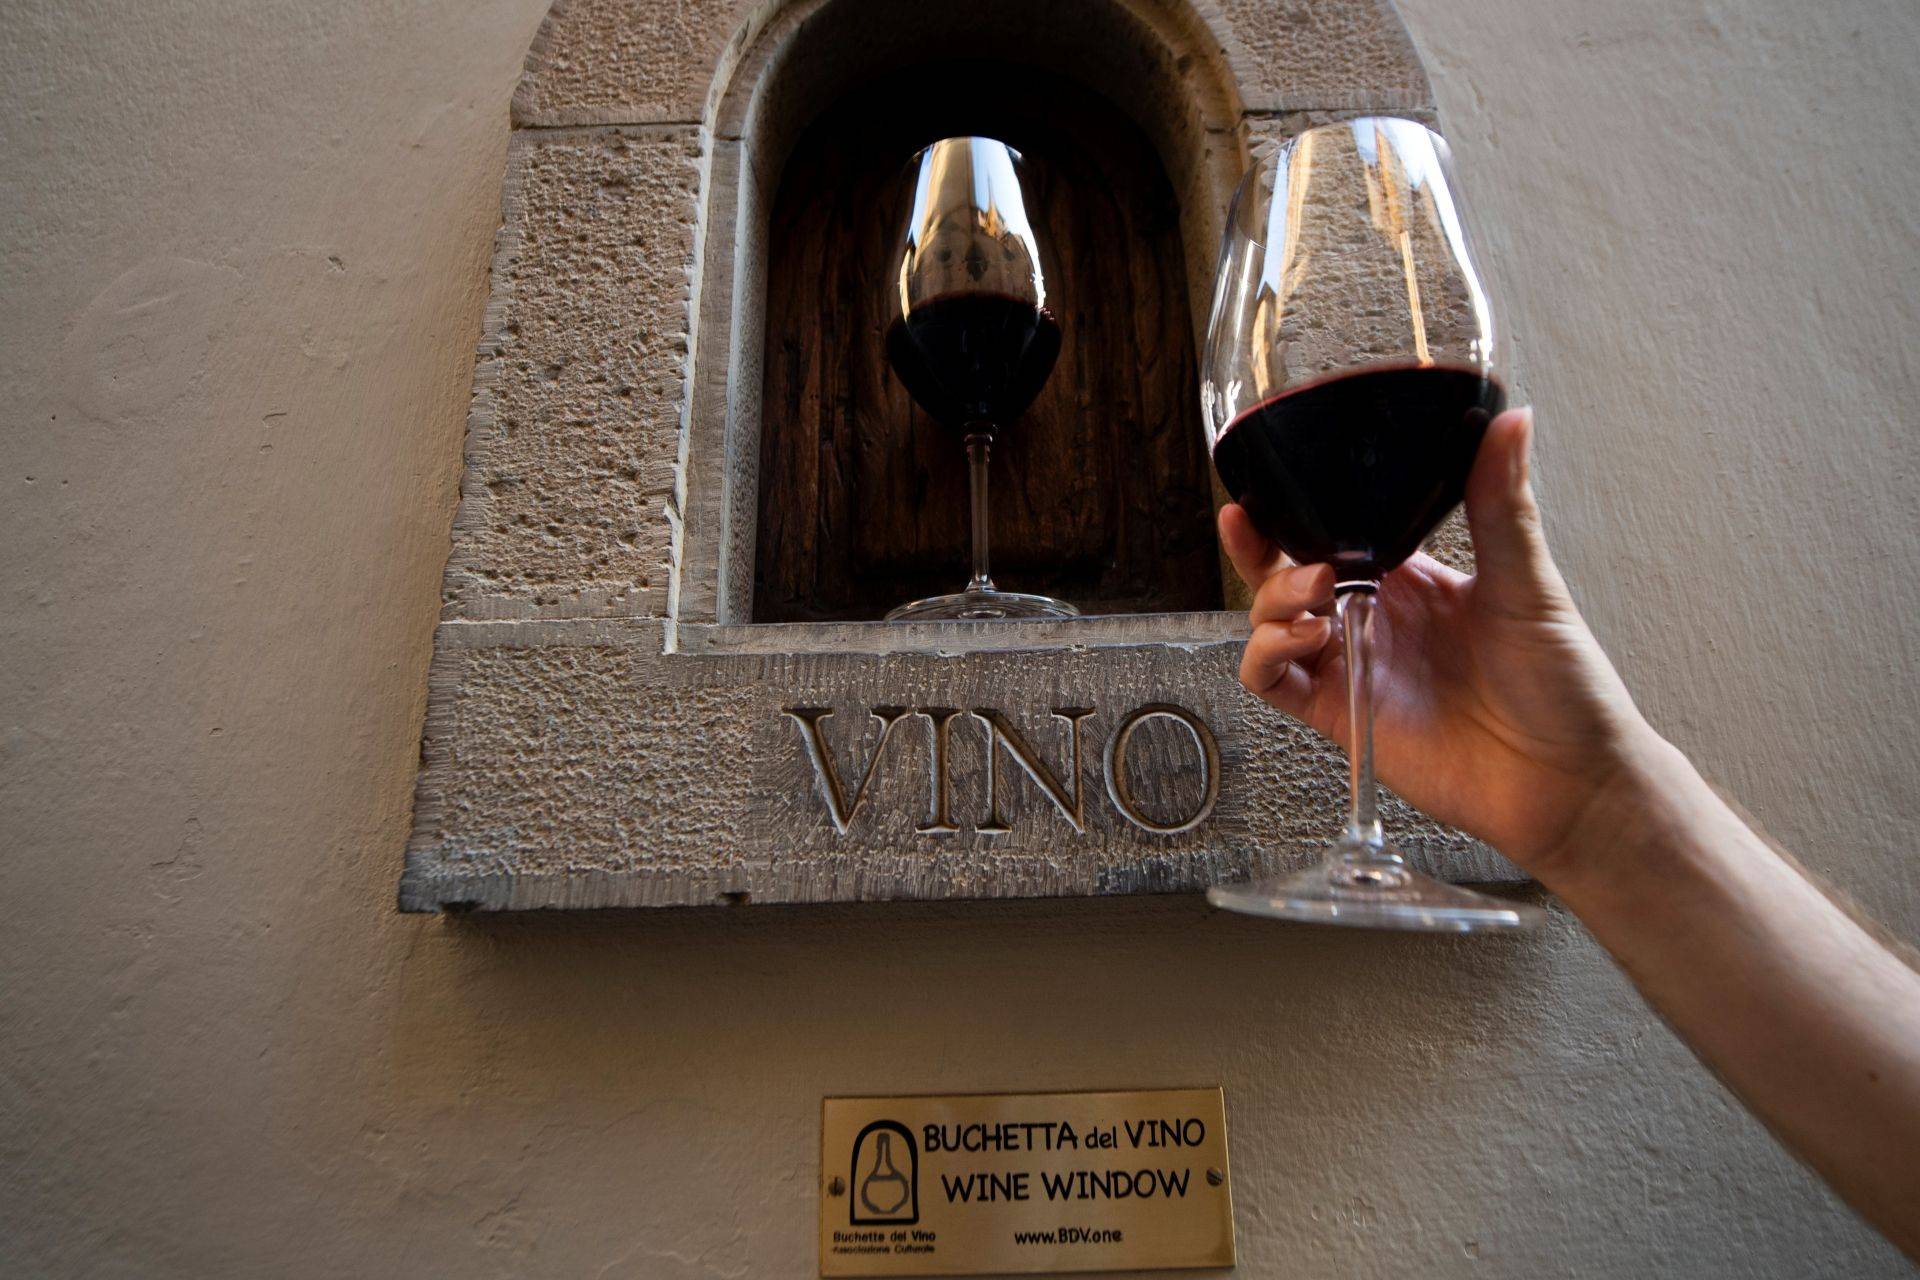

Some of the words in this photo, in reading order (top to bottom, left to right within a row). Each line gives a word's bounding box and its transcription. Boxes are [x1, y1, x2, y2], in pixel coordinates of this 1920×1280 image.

[781, 703, 1221, 835] VINO
[922, 1121, 1078, 1152] BUCHETTA
[1084, 1126, 1118, 1149] del
[1124, 1118, 1206, 1148] VINO
[941, 1171, 1030, 1203] WINE
[1041, 1168, 1190, 1200] WINDOW
[833, 1230, 885, 1243] Buchette
[890, 1230, 907, 1242] del
[911, 1229, 936, 1242] Vino
[1014, 1227, 1123, 1245] www.BDV.one
